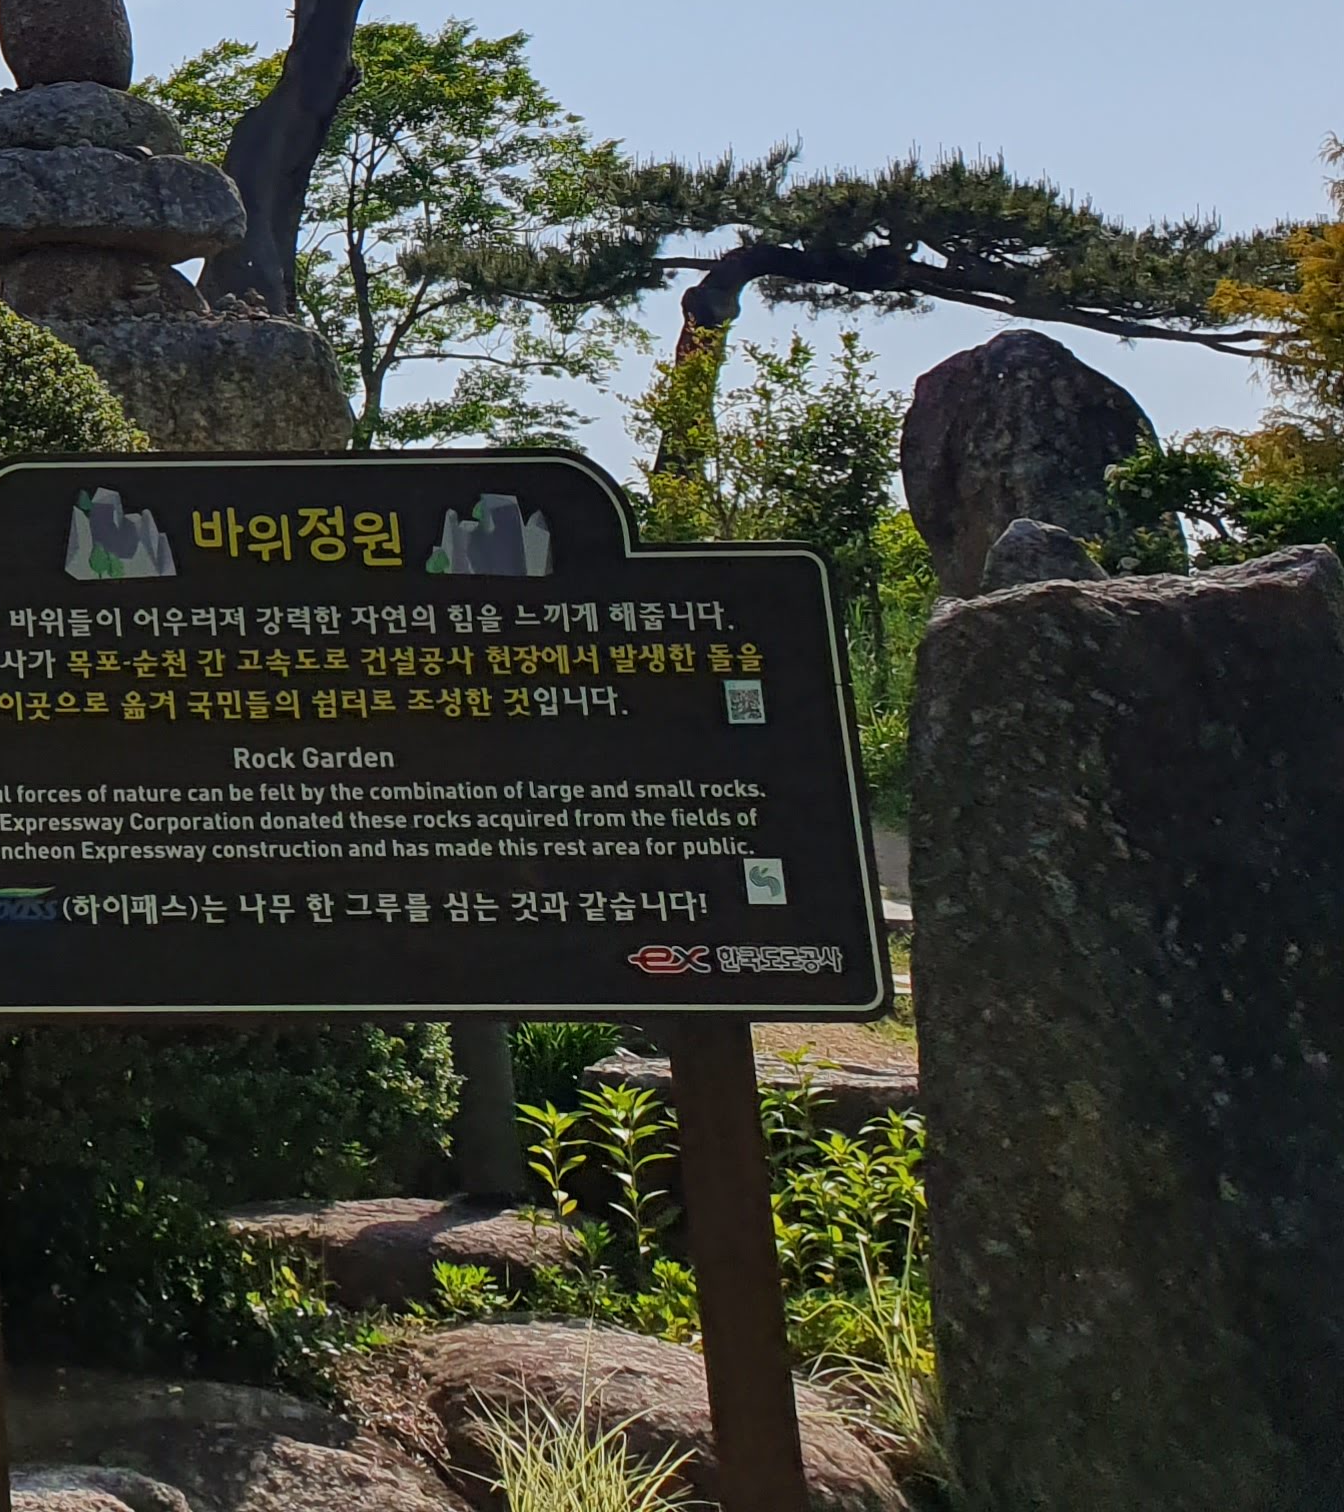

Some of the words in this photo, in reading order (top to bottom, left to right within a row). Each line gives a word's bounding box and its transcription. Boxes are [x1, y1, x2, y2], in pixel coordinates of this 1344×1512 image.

[192, 506, 402, 566] 바위정원
[9, 607, 122, 638] 바위들이
[133, 606, 246, 637] 어우러져
[256, 606, 342, 636] 강력한
[351, 604, 436, 635] 자연의
[447, 604, 502, 633] 힘을
[515, 602, 599, 633] 느끼게
[608, 601, 734, 632] 해줍니다.
[67, 648, 187, 679] 목포-순천
[198, 648, 226, 677] 간
[237, 648, 349, 677] 고속도로
[361, 645, 474, 676] 건설공사
[485, 644, 600, 675] 현장에서
[609, 643, 696, 673] 발생한
[707, 642, 763, 672] 돌을
[121, 690, 176, 720] 옮겨
[187, 689, 301, 720] 국민들의
[311, 688, 396, 719] 쉼터로
[408, 687, 493, 717] 조성한
[503, 686, 628, 716] 것입니다.
[233, 747, 296, 769] Rock
[302, 746, 395, 769] Garden
[16, 785, 82, 803] forces
[87, 784, 107, 803] of
[113, 785, 182, 802] nature
[187, 788, 223, 802] can
[228, 783, 254, 802] be
[259, 783, 296, 801] felt
[300, 783, 325, 805] by
[330, 782, 364, 801] the
[369, 781, 498, 800] combination
[503, 780, 523, 799] of
[528, 781, 585, 803] large
[590, 780, 629, 798] and
[634, 779, 695, 798] small
[700, 779, 766, 798] rocks.
[0, 813, 124, 836] Expressway
[129, 811, 254, 835] Corporation
[260, 811, 344, 830] donated
[349, 810, 407, 829] these
[413, 809, 472, 829] rocks
[476, 808, 569, 832] acquired
[574, 808, 626, 827] from
[631, 808, 666, 827] the
[671, 808, 731, 827] fields
[736, 807, 757, 826] of
[81, 841, 207, 864] Expressway
[212, 839, 343, 859] construction
[348, 839, 387, 857] and
[392, 839, 430, 857] has
[435, 838, 493, 857] made
[498, 837, 538, 856] this
[543, 839, 587, 856] rest
[592, 841, 640, 856] area
[645, 837, 677, 855] for
[682, 836, 755, 860] public.
[62, 894, 227, 925] (하이패스)는
[239, 893, 295, 924] 나무
[306, 893, 335, 923] 한
[345, 893, 431, 923] 그루를
[443, 891, 500, 922] 심는
[511, 891, 570, 922] 것과
[578, 890, 708, 922] 같습니다!
[716, 945, 843, 974] 한국도로공사
